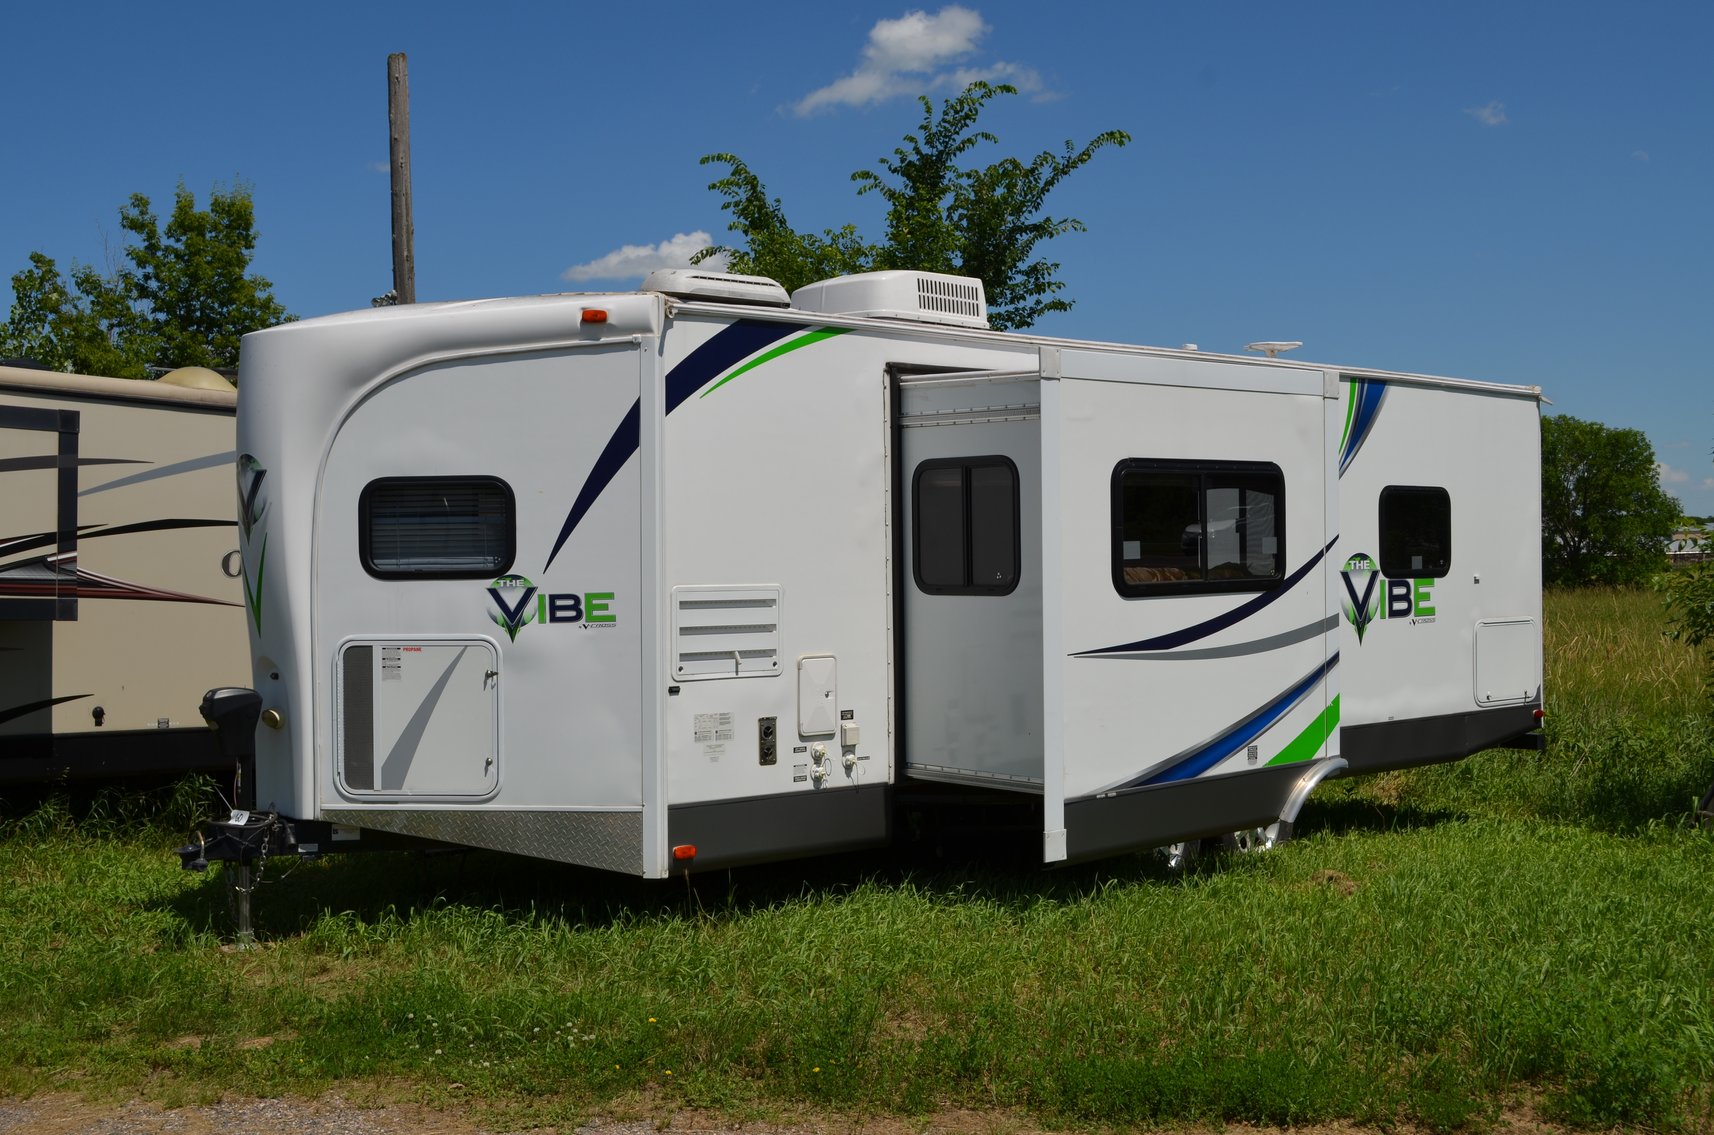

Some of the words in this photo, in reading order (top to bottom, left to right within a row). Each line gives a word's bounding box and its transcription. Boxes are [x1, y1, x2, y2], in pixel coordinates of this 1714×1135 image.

[1349, 560, 1370, 569] THE
[498, 579, 524, 587] THE
[486, 586, 617, 630] VIBE
[1340, 569, 1436, 630] VIBE
